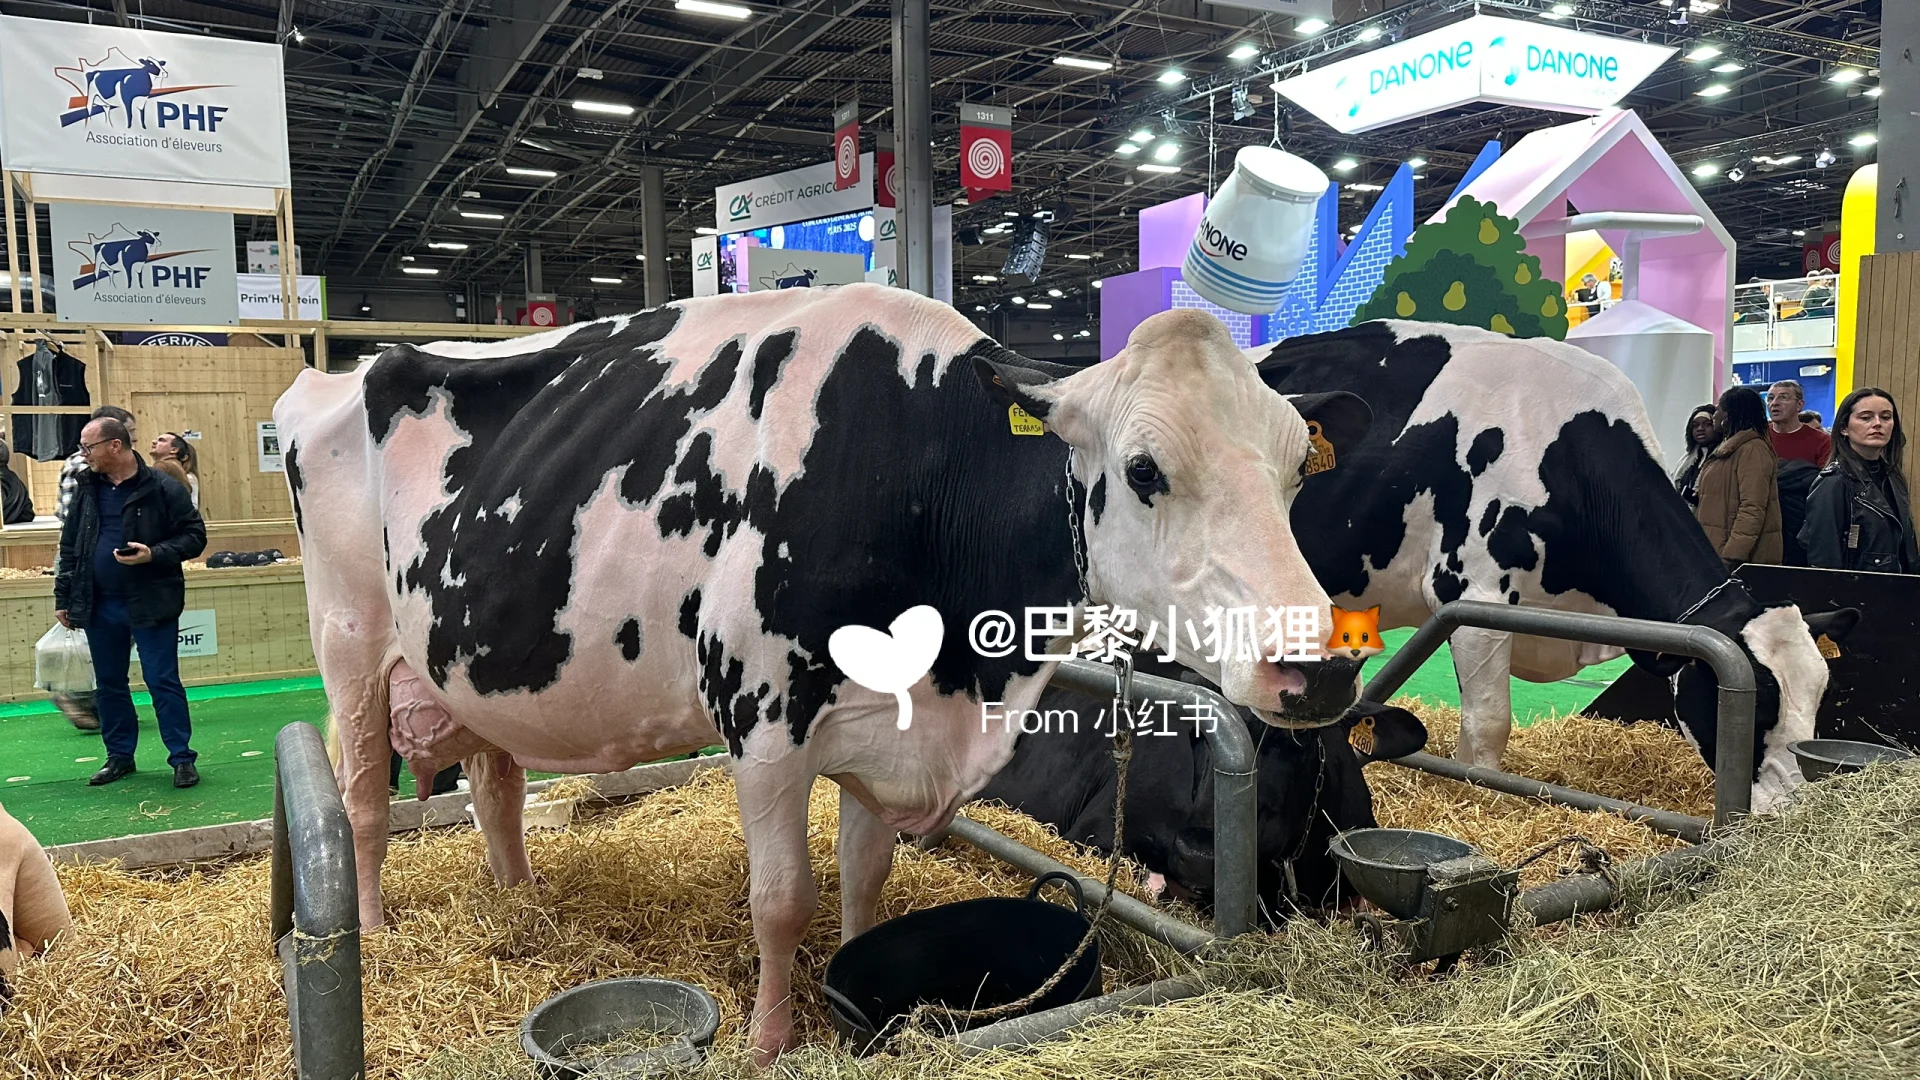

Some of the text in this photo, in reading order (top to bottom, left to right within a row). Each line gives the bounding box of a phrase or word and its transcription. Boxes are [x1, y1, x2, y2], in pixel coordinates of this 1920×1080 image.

[157, 101, 229, 133] PHF
[976, 111, 994, 121] 1311
[86, 131, 222, 153] Association d'éleveurs
[755, 190, 795, 208] CRÉDIT
[152, 265, 212, 289] PHF
[94, 291, 207, 306] Association d'éleveurs
[240, 293, 319, 305] Prim'Hltein
[1306, 453, 1335, 474] 8540
[1351, 732, 1372, 754] 1480
